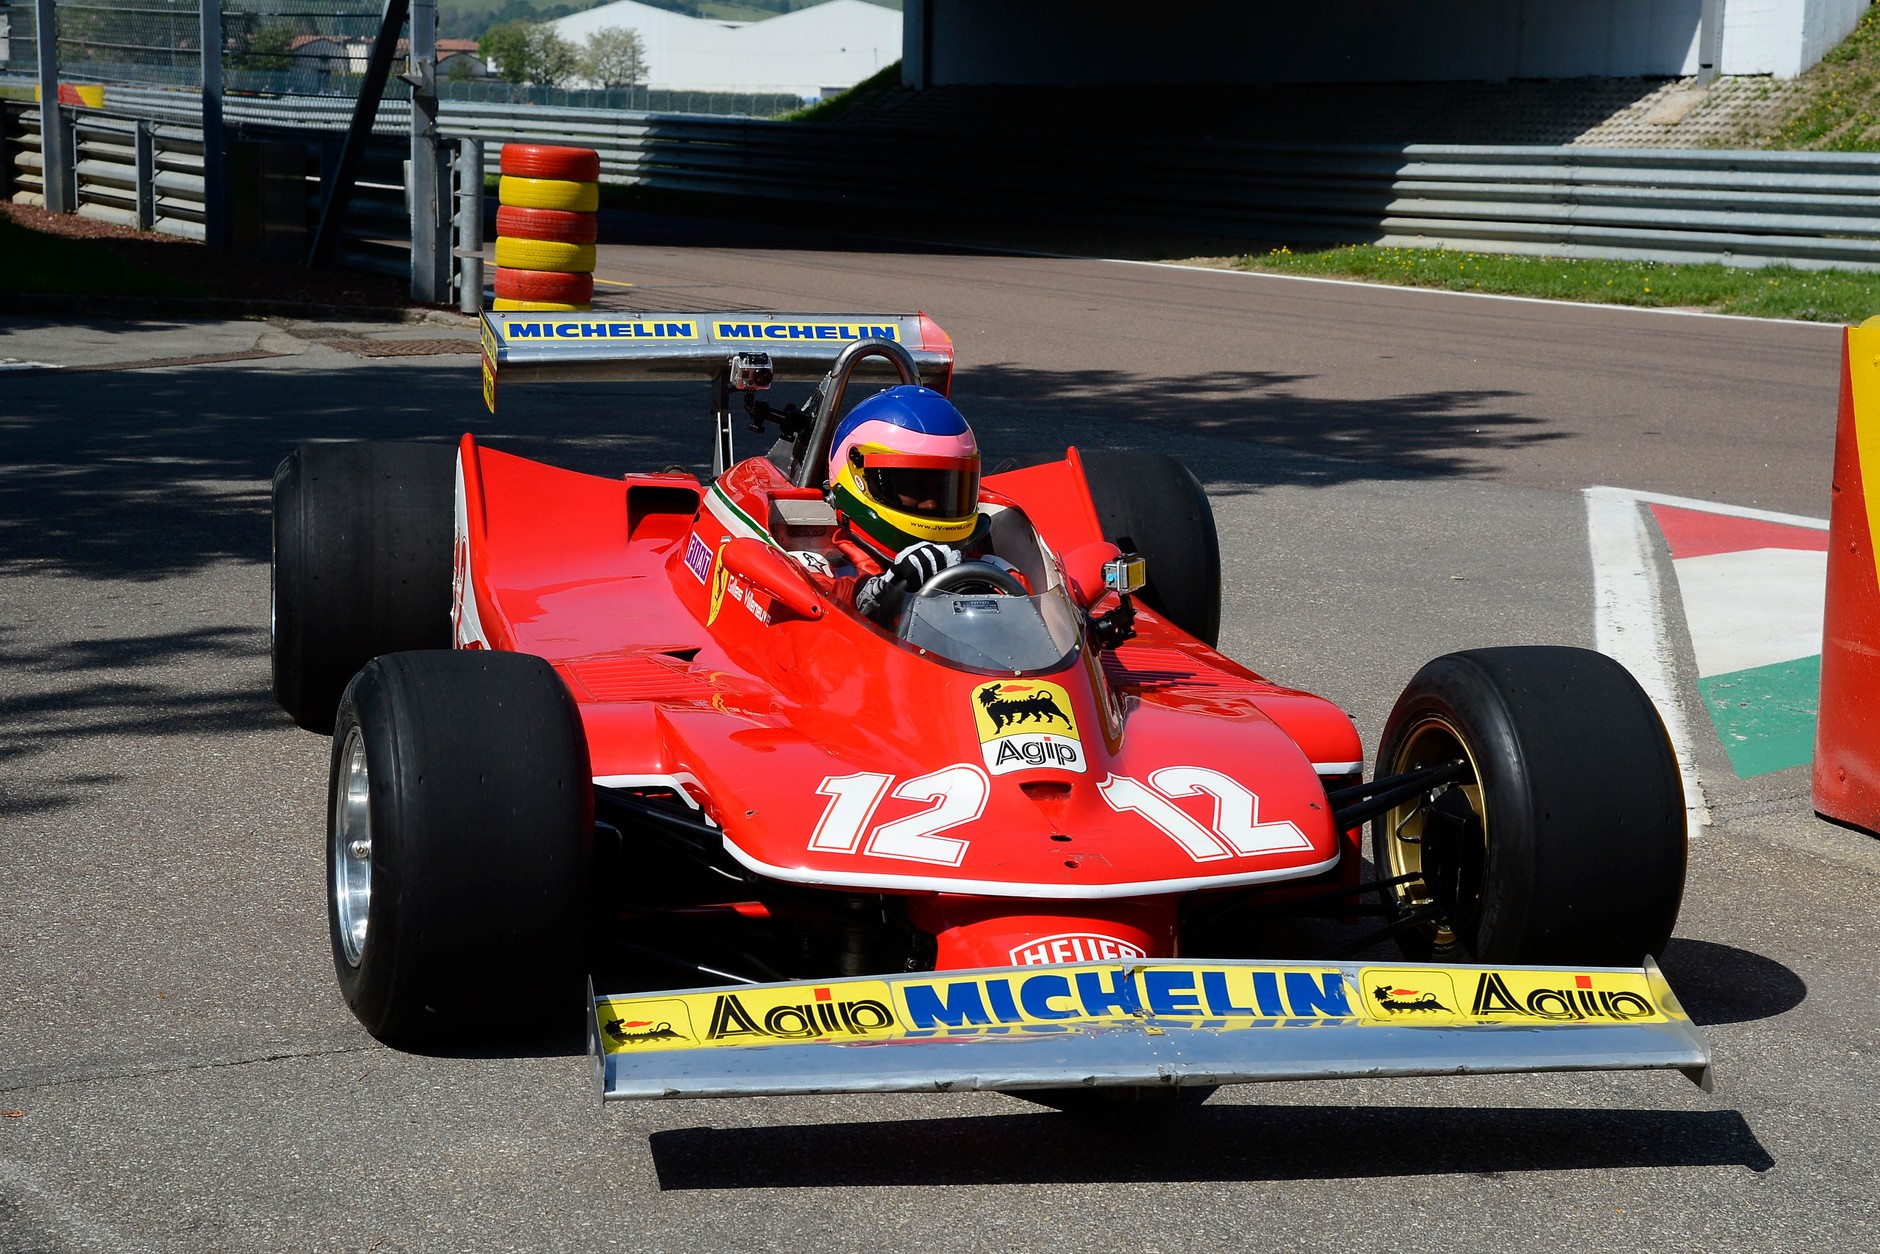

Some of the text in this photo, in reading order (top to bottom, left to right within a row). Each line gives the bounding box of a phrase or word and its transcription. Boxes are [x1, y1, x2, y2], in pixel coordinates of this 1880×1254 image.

[508, 322, 693, 339] MICHELIN
[718, 322, 896, 341] MICHELIN
[686, 537, 712, 579] FIAT
[995, 736, 1078, 768] Agip
[807, 762, 991, 867] 12
[1096, 765, 1315, 863] 12
[706, 969, 1657, 1041] Agip MICHELIN Agip
